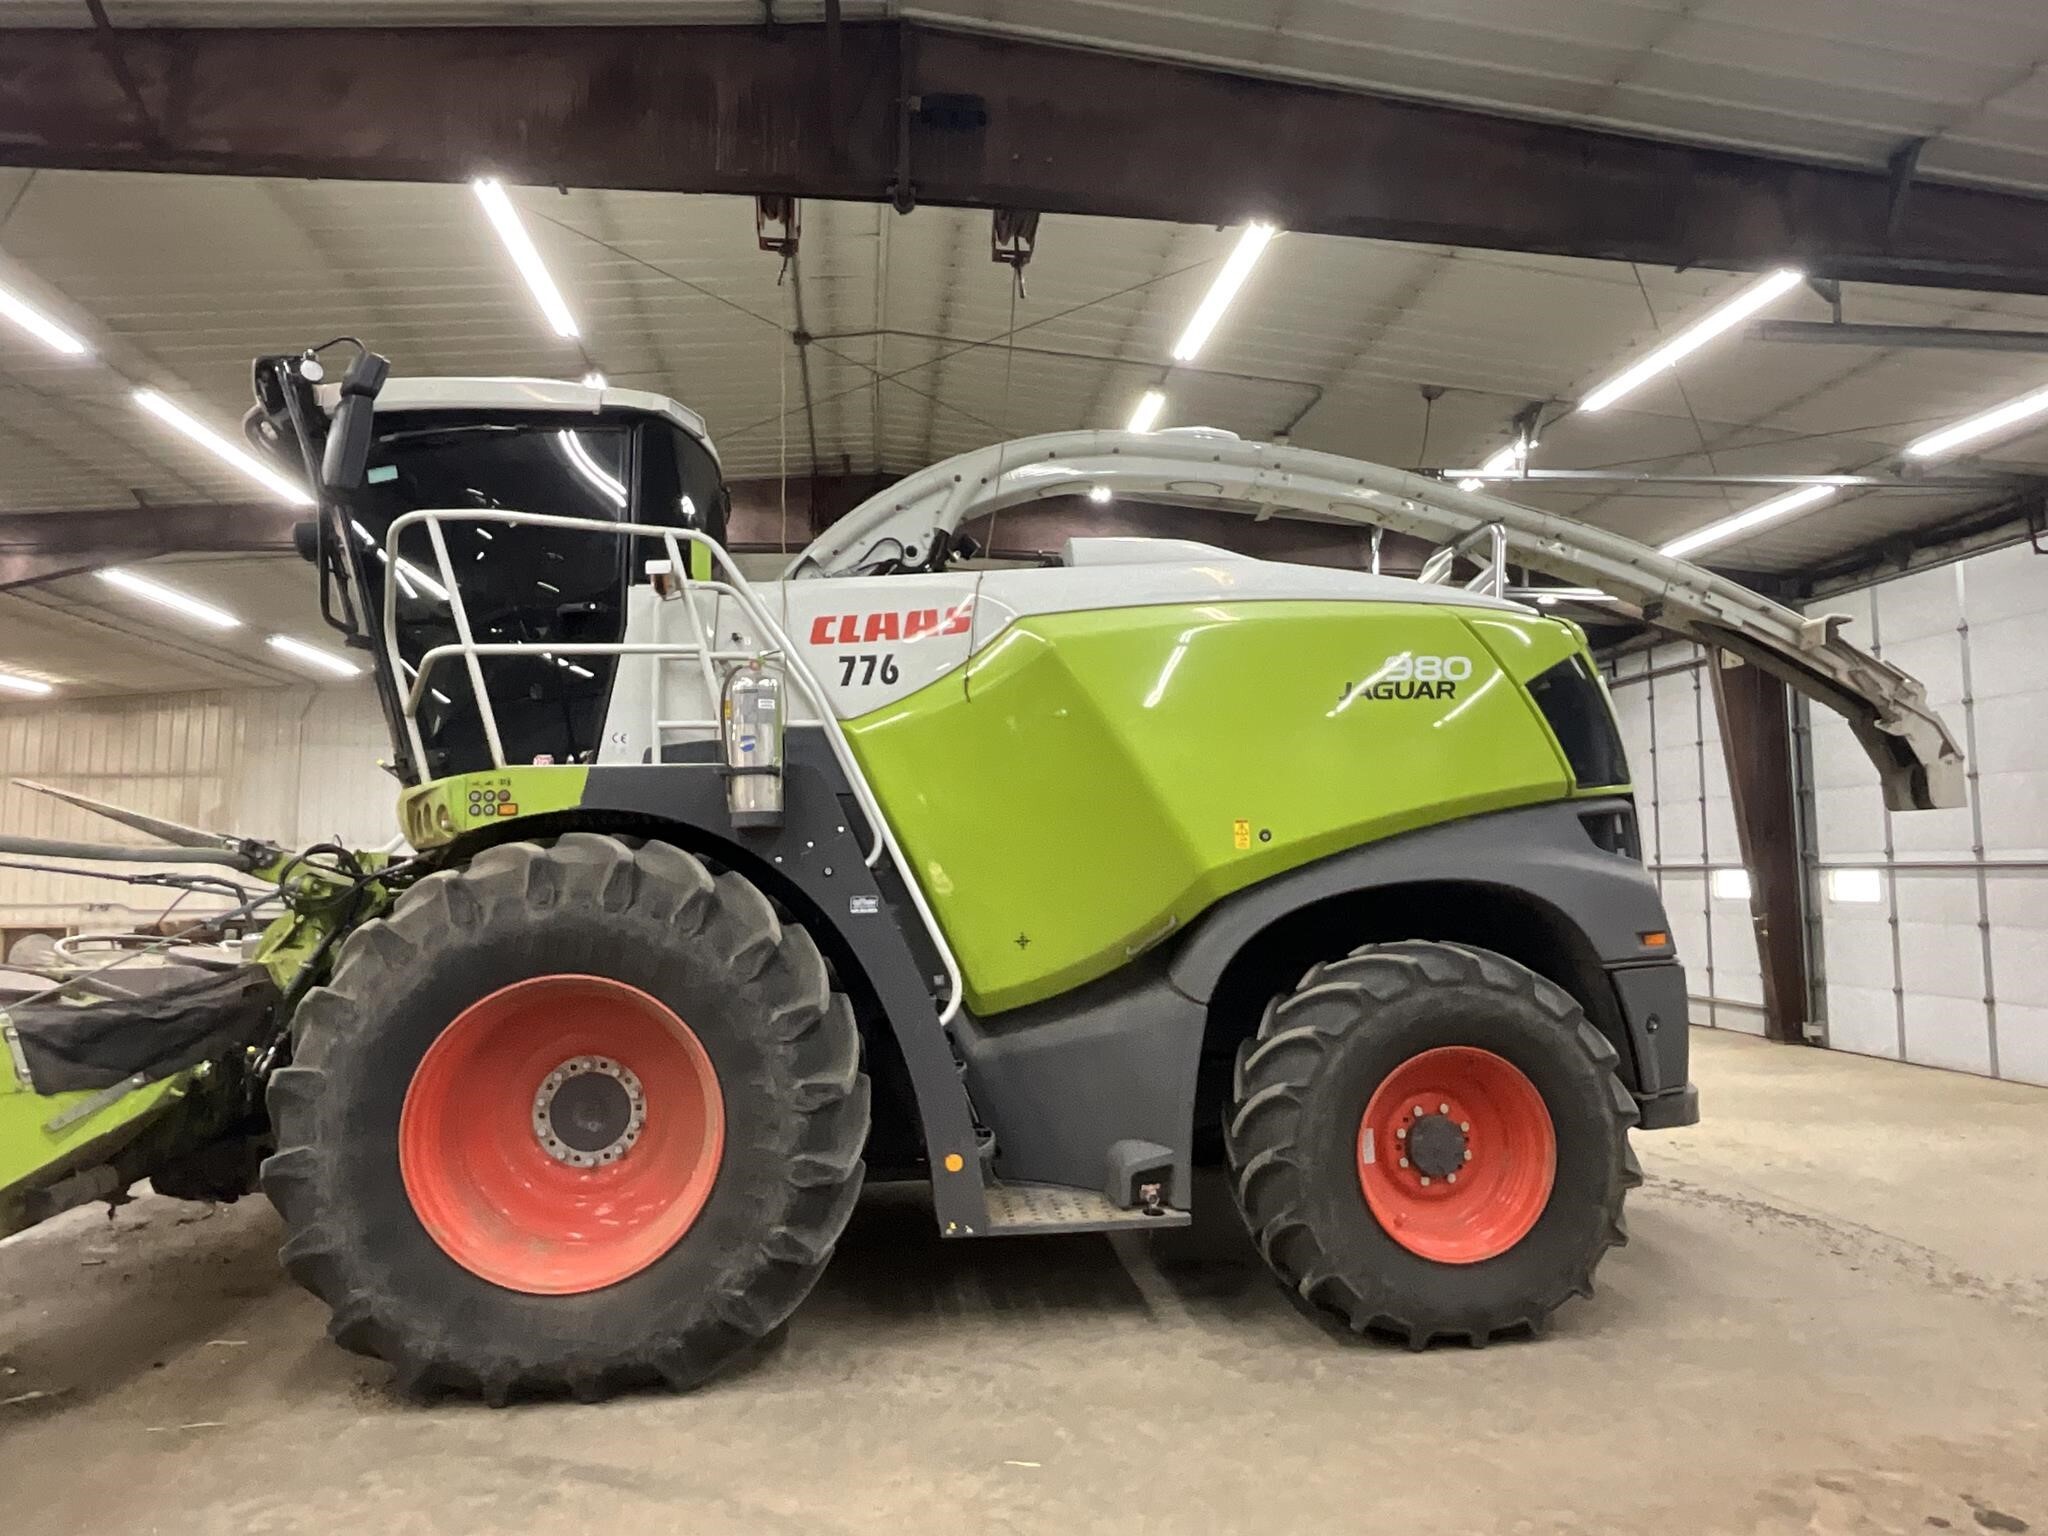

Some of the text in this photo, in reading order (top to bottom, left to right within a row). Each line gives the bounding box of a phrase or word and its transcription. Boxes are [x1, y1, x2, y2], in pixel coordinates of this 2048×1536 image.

[810, 605, 972, 645] CLAAS
[839, 654, 899, 687] 776
[1384, 656, 1472, 681] 980
